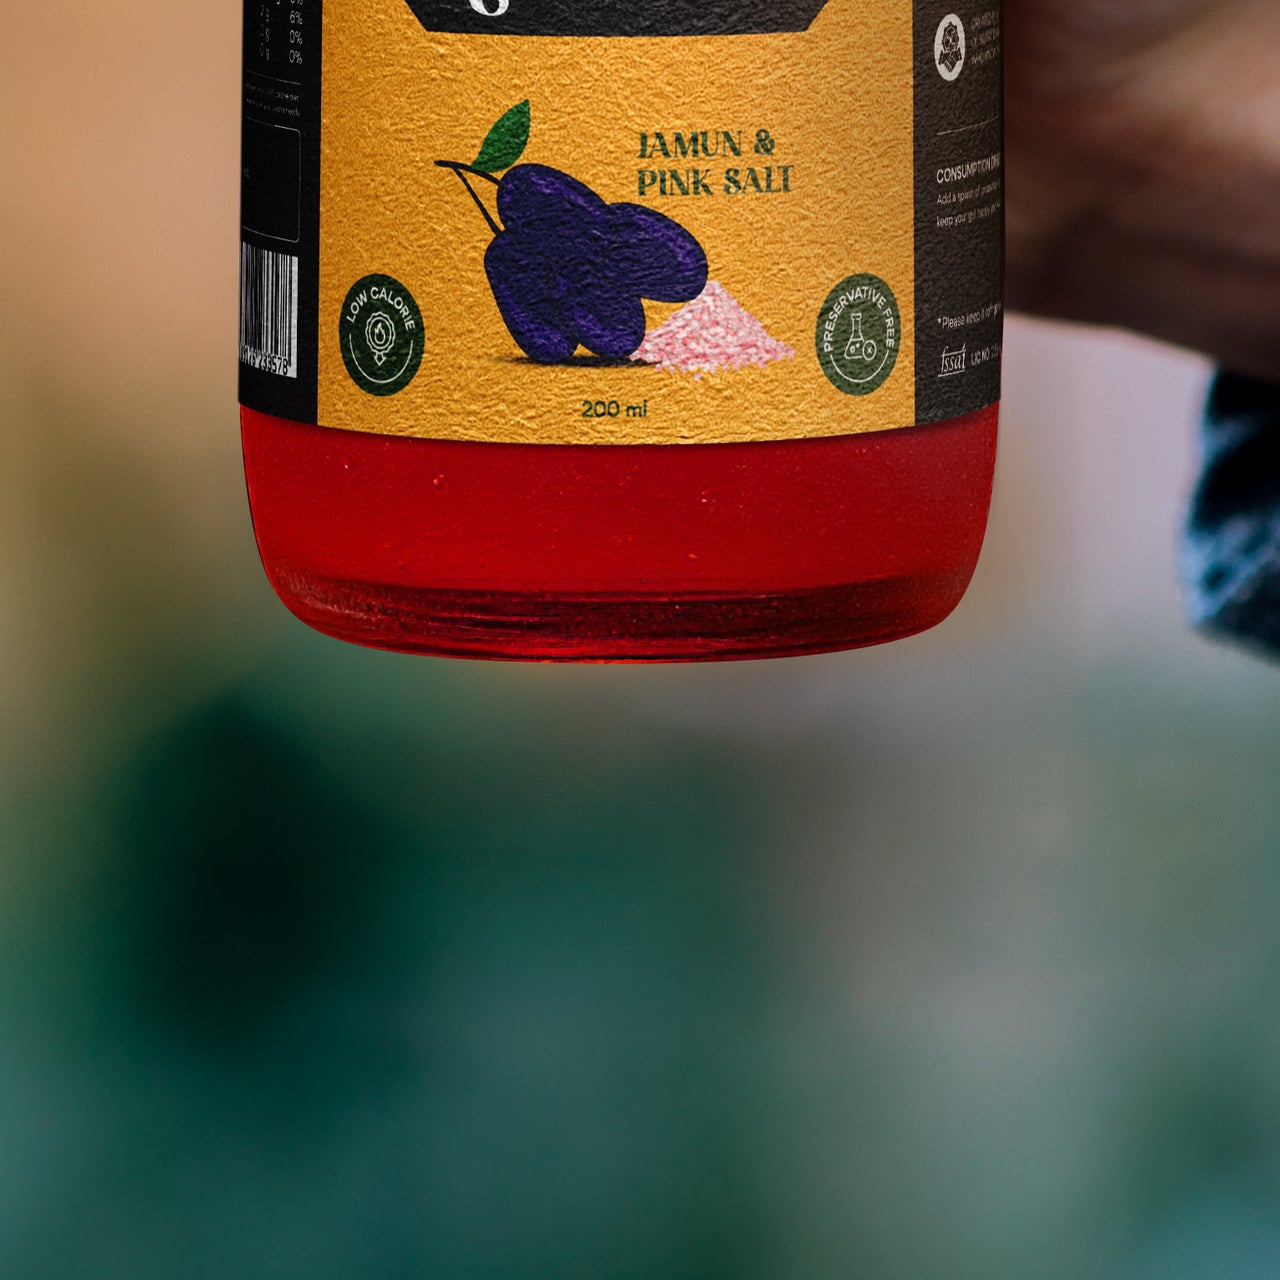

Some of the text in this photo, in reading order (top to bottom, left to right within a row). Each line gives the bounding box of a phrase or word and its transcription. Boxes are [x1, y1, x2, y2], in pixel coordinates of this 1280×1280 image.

[290, 9, 303, 25] 6%
[289, 29, 303, 45] 0%
[289, 49, 303, 65] 0%
[638, 128, 775, 159] JAMUN &
[638, 164, 795, 197] PINK SALT
[937, 191, 951, 205] Add
[346, 286, 416, 332] LOW CALORIE
[823, 286, 895, 353] PRESERVATIVE FREE
[581, 399, 648, 419] 200 ml
